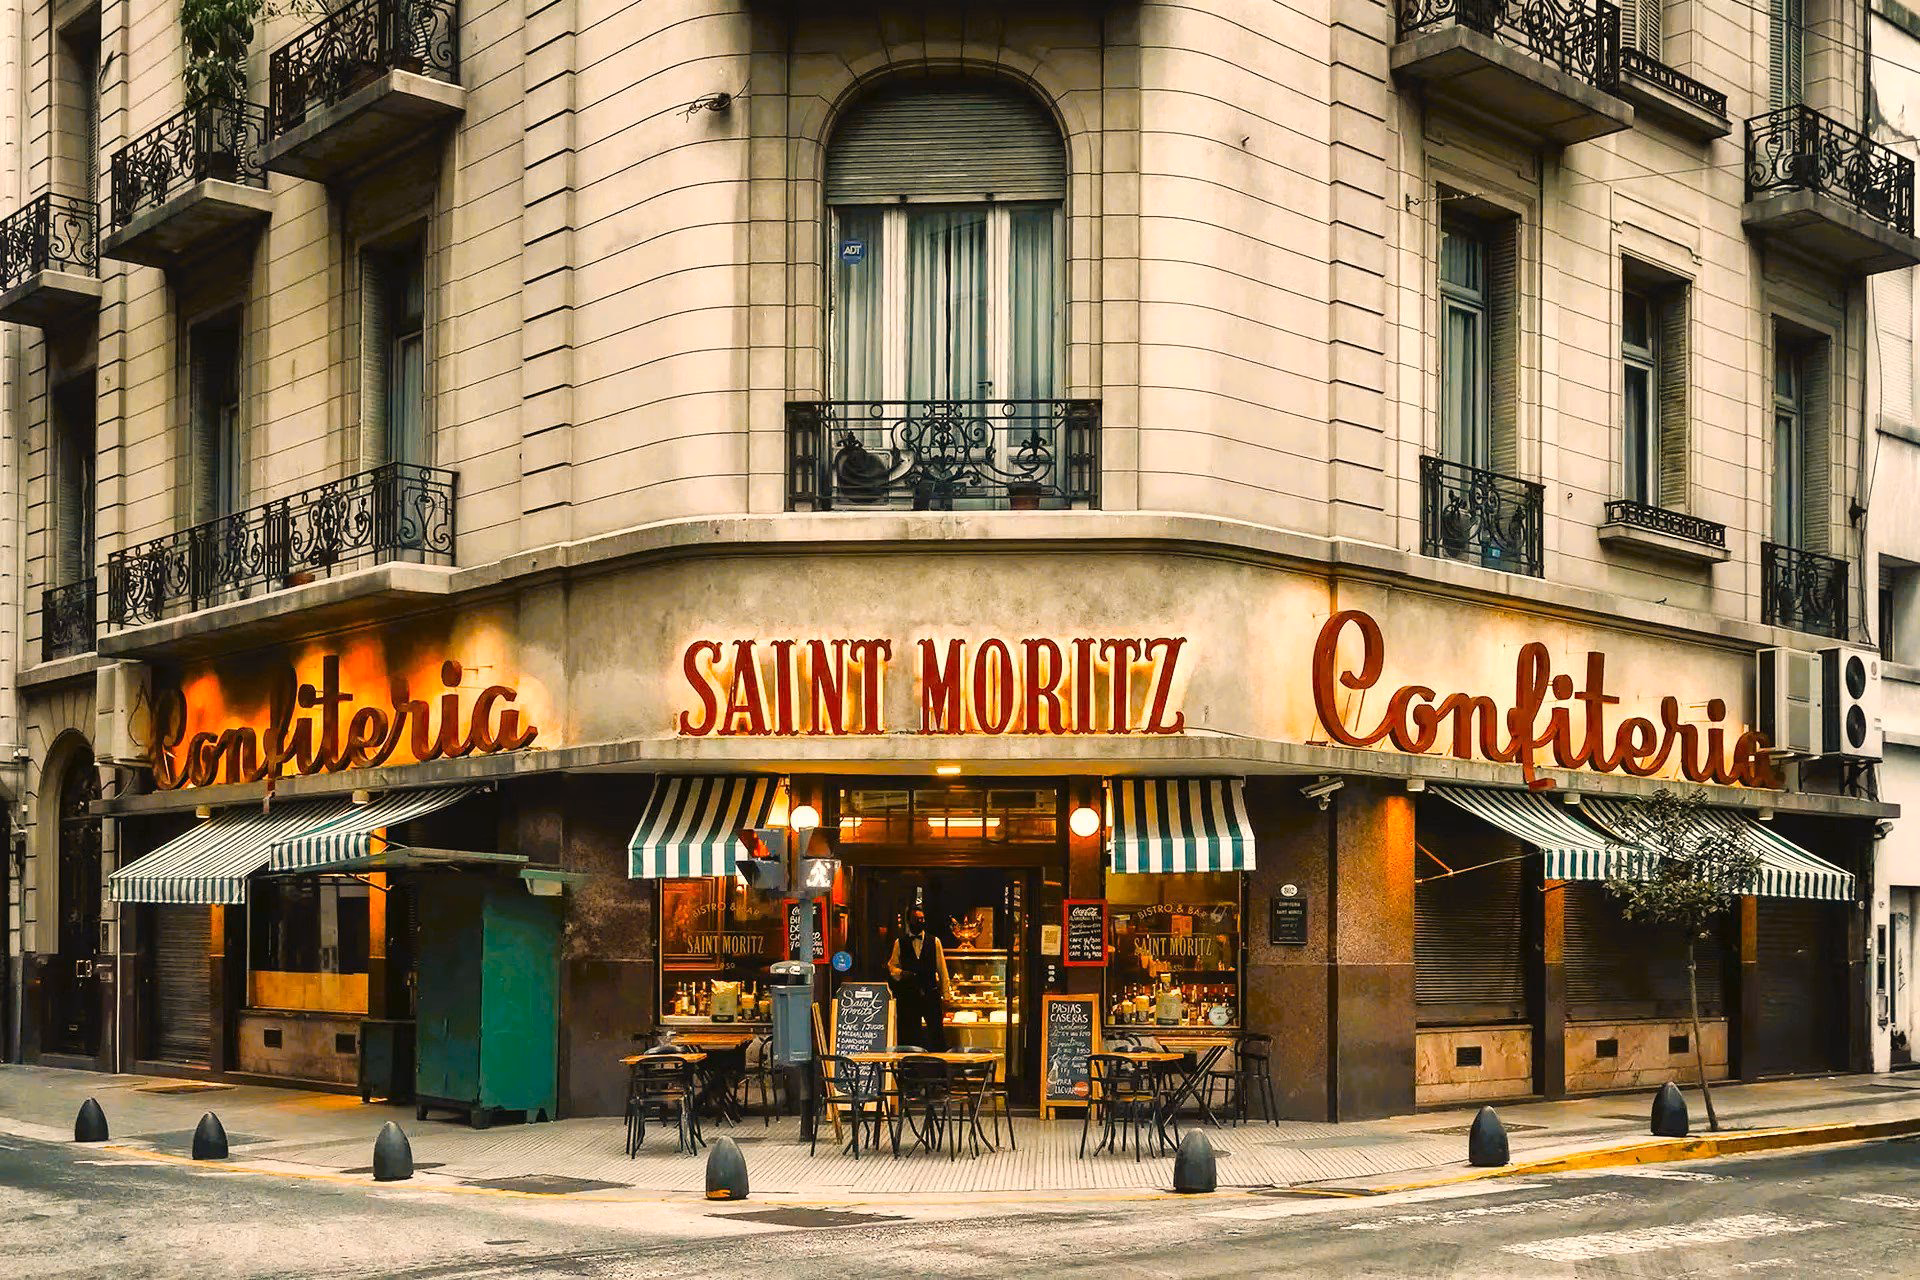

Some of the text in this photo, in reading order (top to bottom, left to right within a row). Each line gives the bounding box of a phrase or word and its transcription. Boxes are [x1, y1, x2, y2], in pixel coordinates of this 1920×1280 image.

[843, 245, 861, 255] ADT
[679, 636, 1188, 737] SAINT MORITZ
[1137, 903, 1172, 920] BISTRO
[1177, 904, 1184, 913] &
[687, 935, 764, 954] SAINT MORITZ
[1134, 937, 1212, 956] SAINT MORITZ
[1052, 1002, 1082, 1014] PASTAS
[1050, 1013, 1089, 1023] CASERAS
